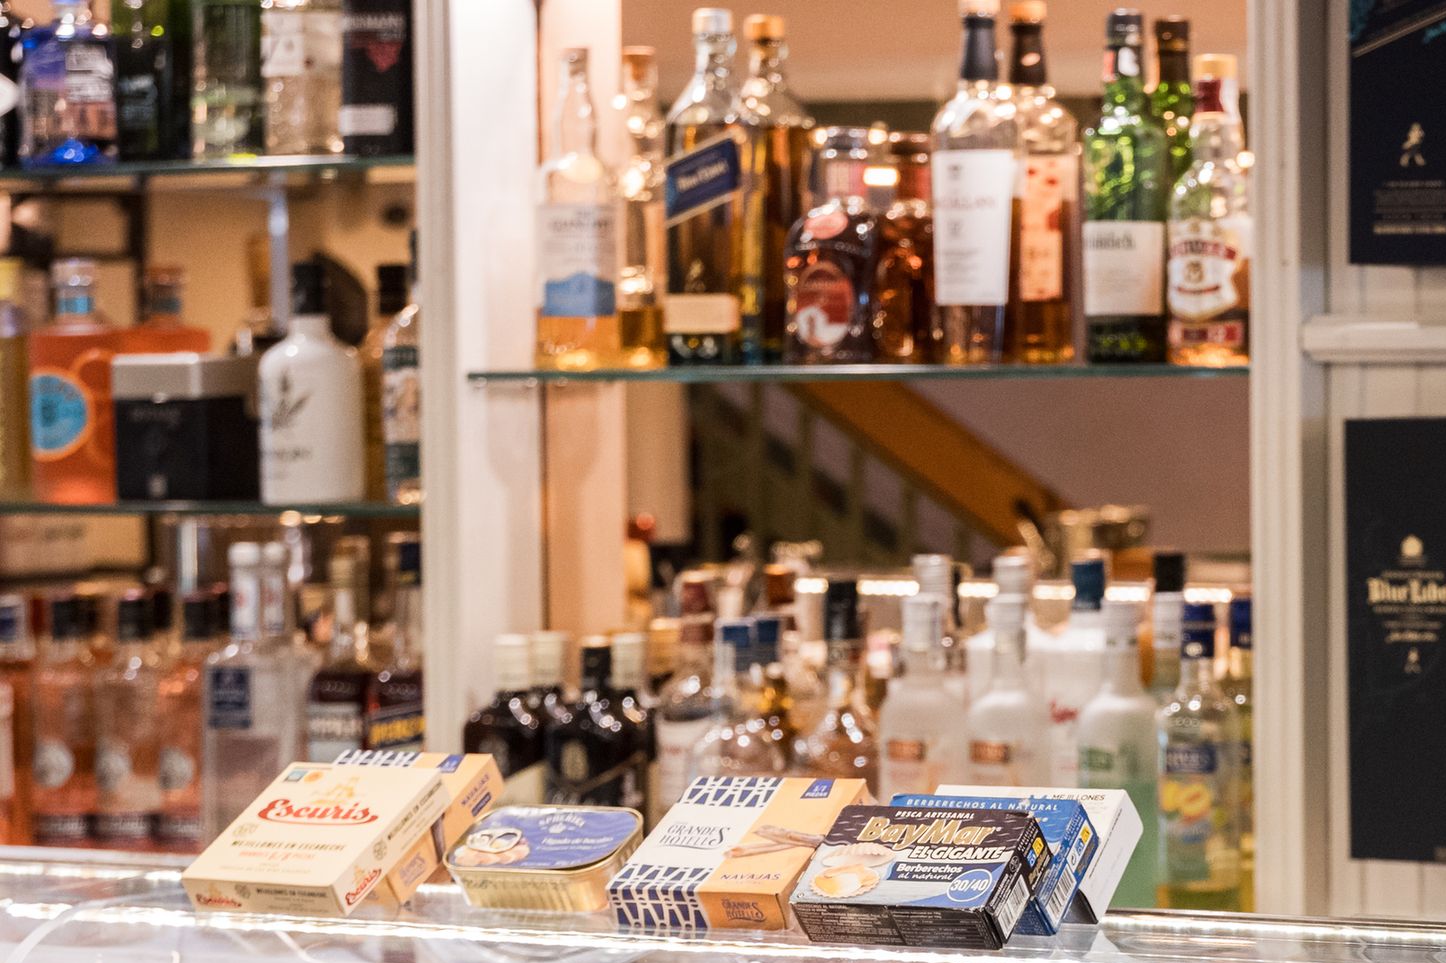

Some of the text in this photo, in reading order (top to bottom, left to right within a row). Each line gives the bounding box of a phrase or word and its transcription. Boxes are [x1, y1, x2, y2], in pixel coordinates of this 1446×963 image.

[906, 799, 986, 809] BERBERECHOS
[1007, 803, 1058, 811] NATURAL
[258, 798, 379, 826] Escuris
[857, 816, 996, 850] BayMar
[930, 847, 1006, 861] GIGANTE
[896, 863, 963, 873] Berberechos
[720, 873, 781, 881] NAVAJAS
[897, 872, 954, 881] al natural
[950, 878, 989, 891] 30/40
